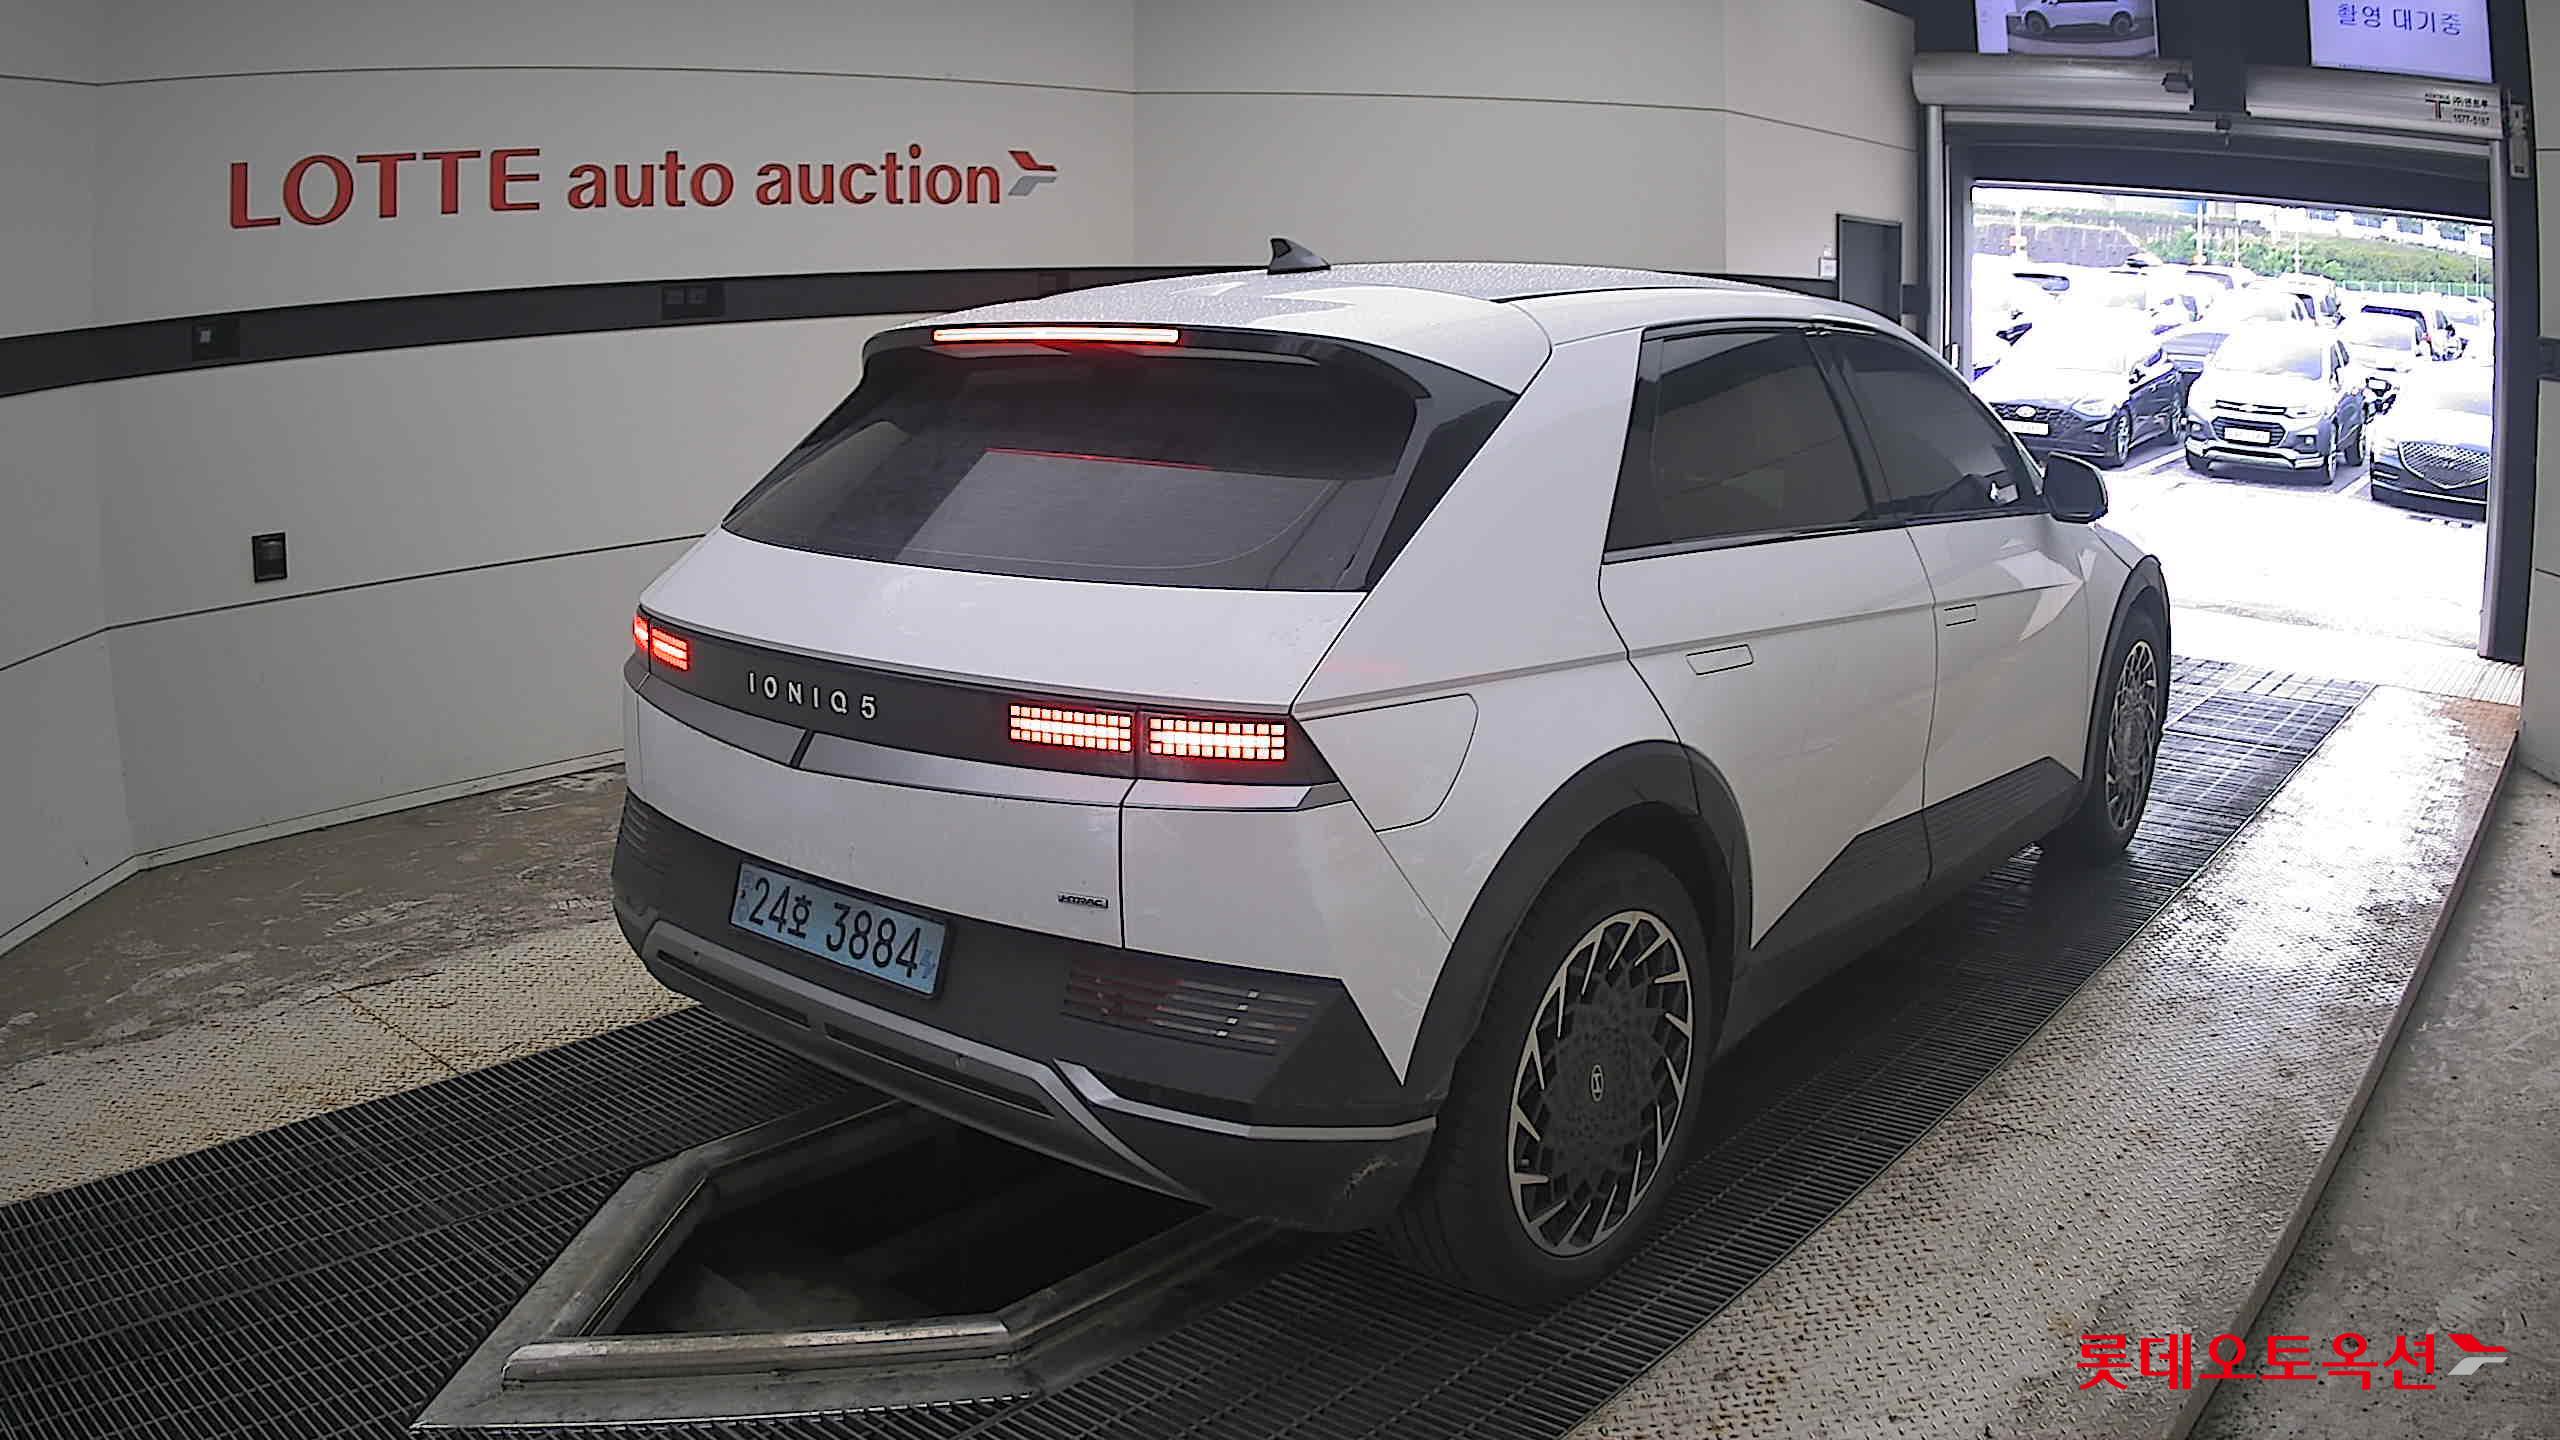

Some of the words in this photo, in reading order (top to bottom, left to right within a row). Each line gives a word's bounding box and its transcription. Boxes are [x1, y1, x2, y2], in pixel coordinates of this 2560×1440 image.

[2338, 3, 2381, 28] 촬영
[2393, 8, 2461, 36] 대기중
[230, 148, 541, 229] LOTTE
[568, 150, 735, 208] auto
[755, 145, 1002, 205] auction
[748, 876, 814, 941] 24호
[825, 900, 923, 979] 3884
